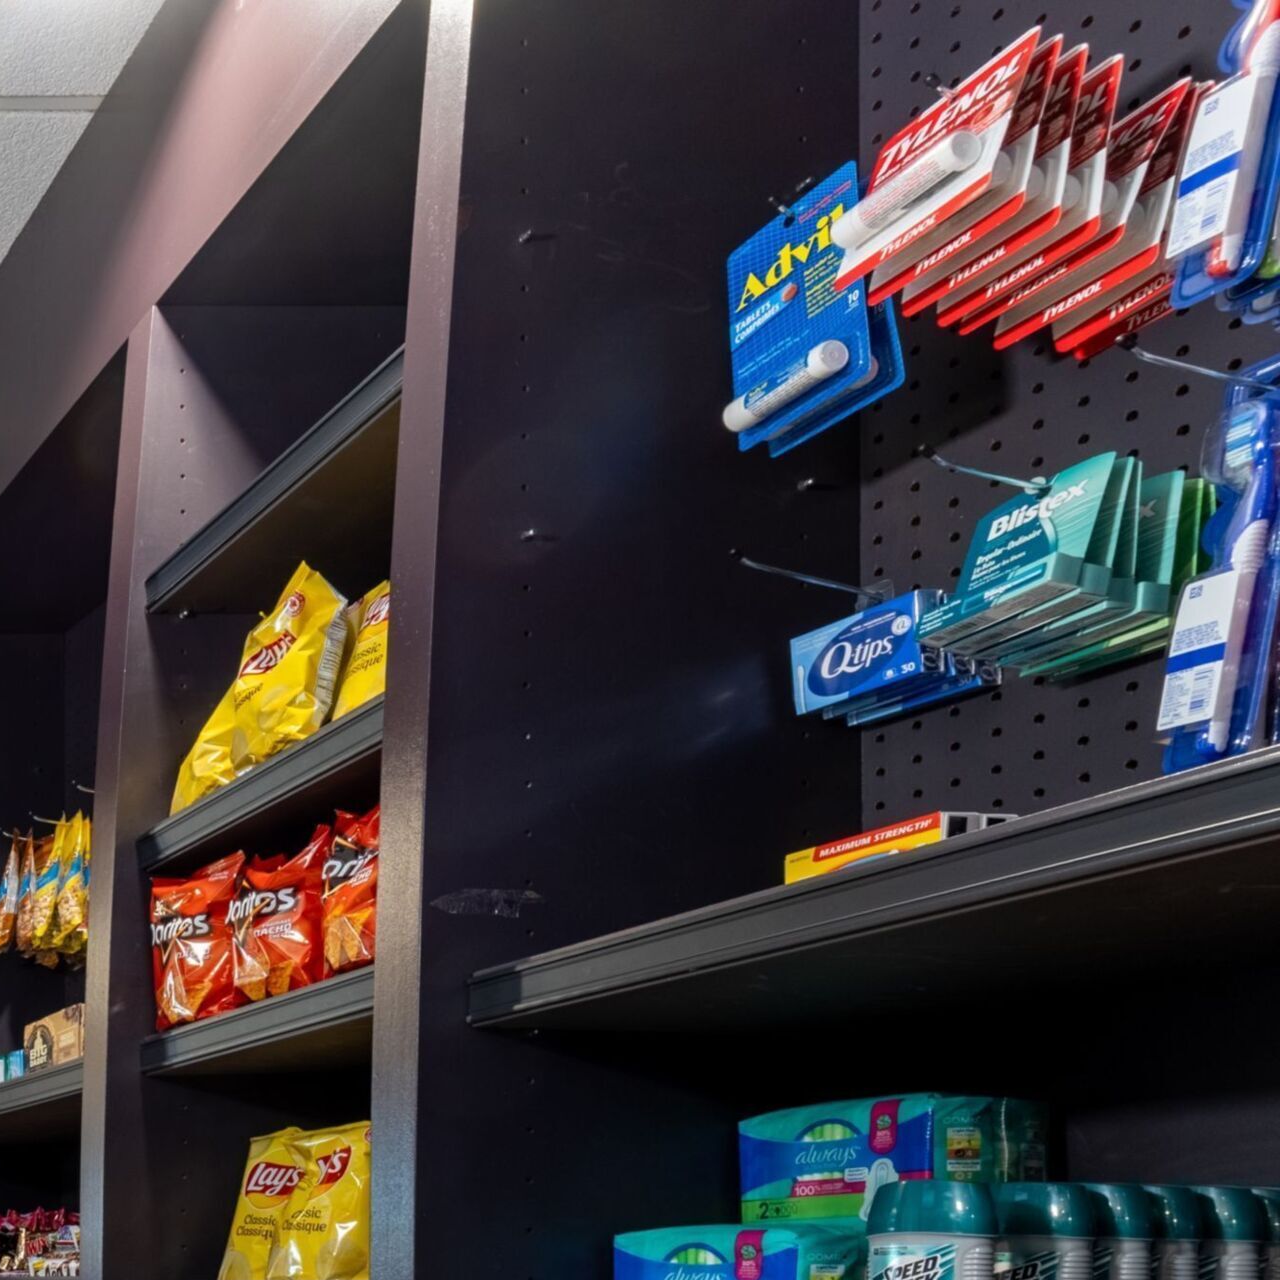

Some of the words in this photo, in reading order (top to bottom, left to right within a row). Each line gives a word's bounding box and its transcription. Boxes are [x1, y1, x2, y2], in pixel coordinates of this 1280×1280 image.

[876, 54, 1022, 185] TYLENOL
[880, 214, 938, 261] TYLENOL
[915, 230, 973, 276] TYLENOL
[948, 246, 1007, 288] TYLENOL
[985, 257, 1045, 298] TYLENOL
[734, 302, 771, 333] TABLETS
[1042, 279, 1103, 323] TYLENOL
[1126, 301, 1172, 331] TYLEN
[987, 479, 1088, 541] Blistex
[820, 636, 893, 679] Q-tips
[901, 662, 915, 673] 30
[819, 836, 871, 858] MAXIMUM
[873, 820, 929, 842] STRENGTH
[795, 1144, 857, 1167] always
[246, 1162, 302, 1196] Lay's
[759, 1202, 770, 1219] 2
[236, 1226, 273, 1239] Classiqu
